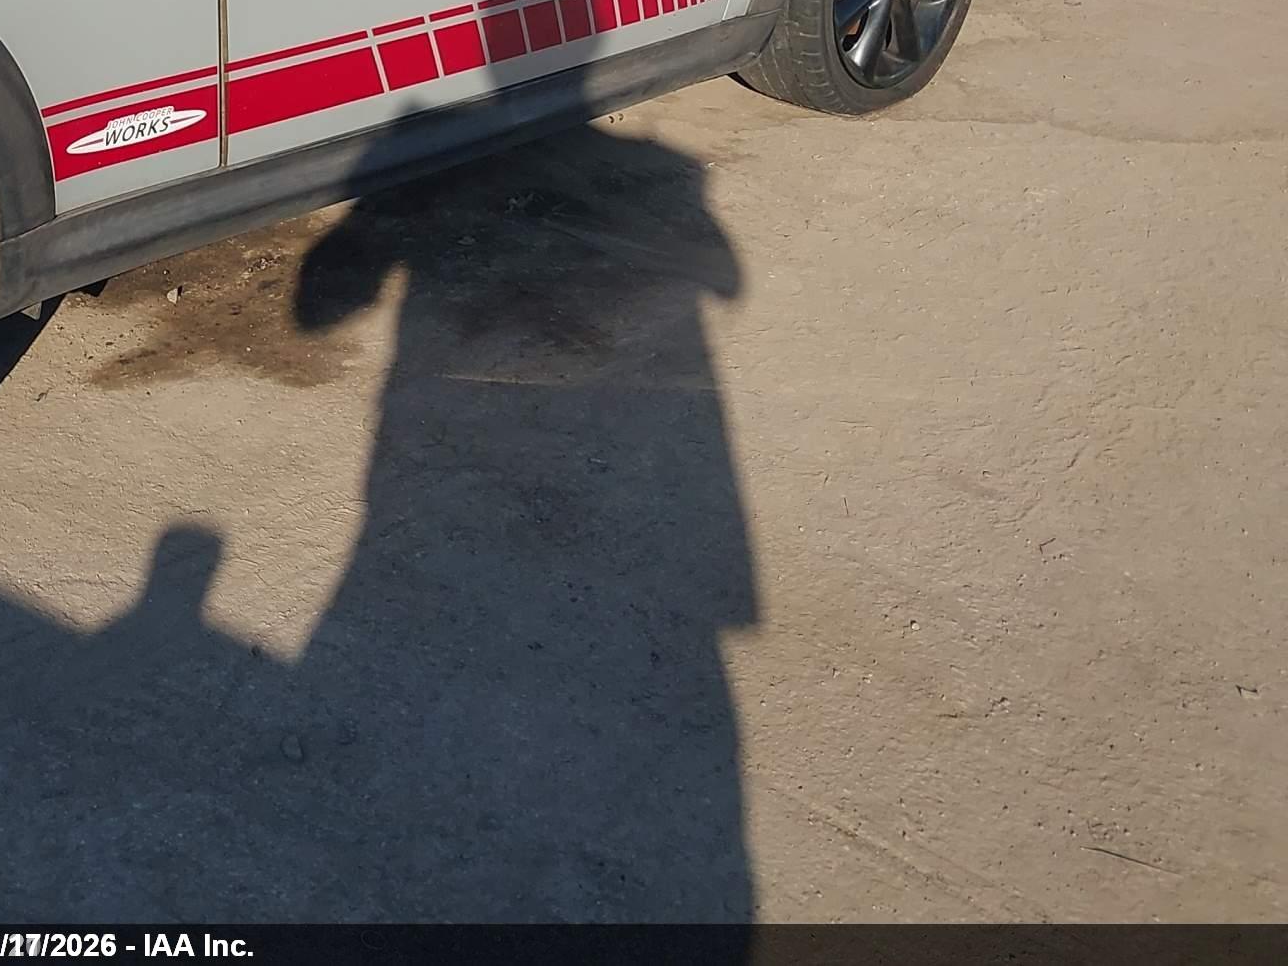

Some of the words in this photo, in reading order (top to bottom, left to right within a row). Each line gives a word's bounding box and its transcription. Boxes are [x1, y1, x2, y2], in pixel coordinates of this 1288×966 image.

[105, 116, 171, 147] WORKS
[107, 117, 136, 130] JOHN
[136, 107, 173, 123] COOPER
